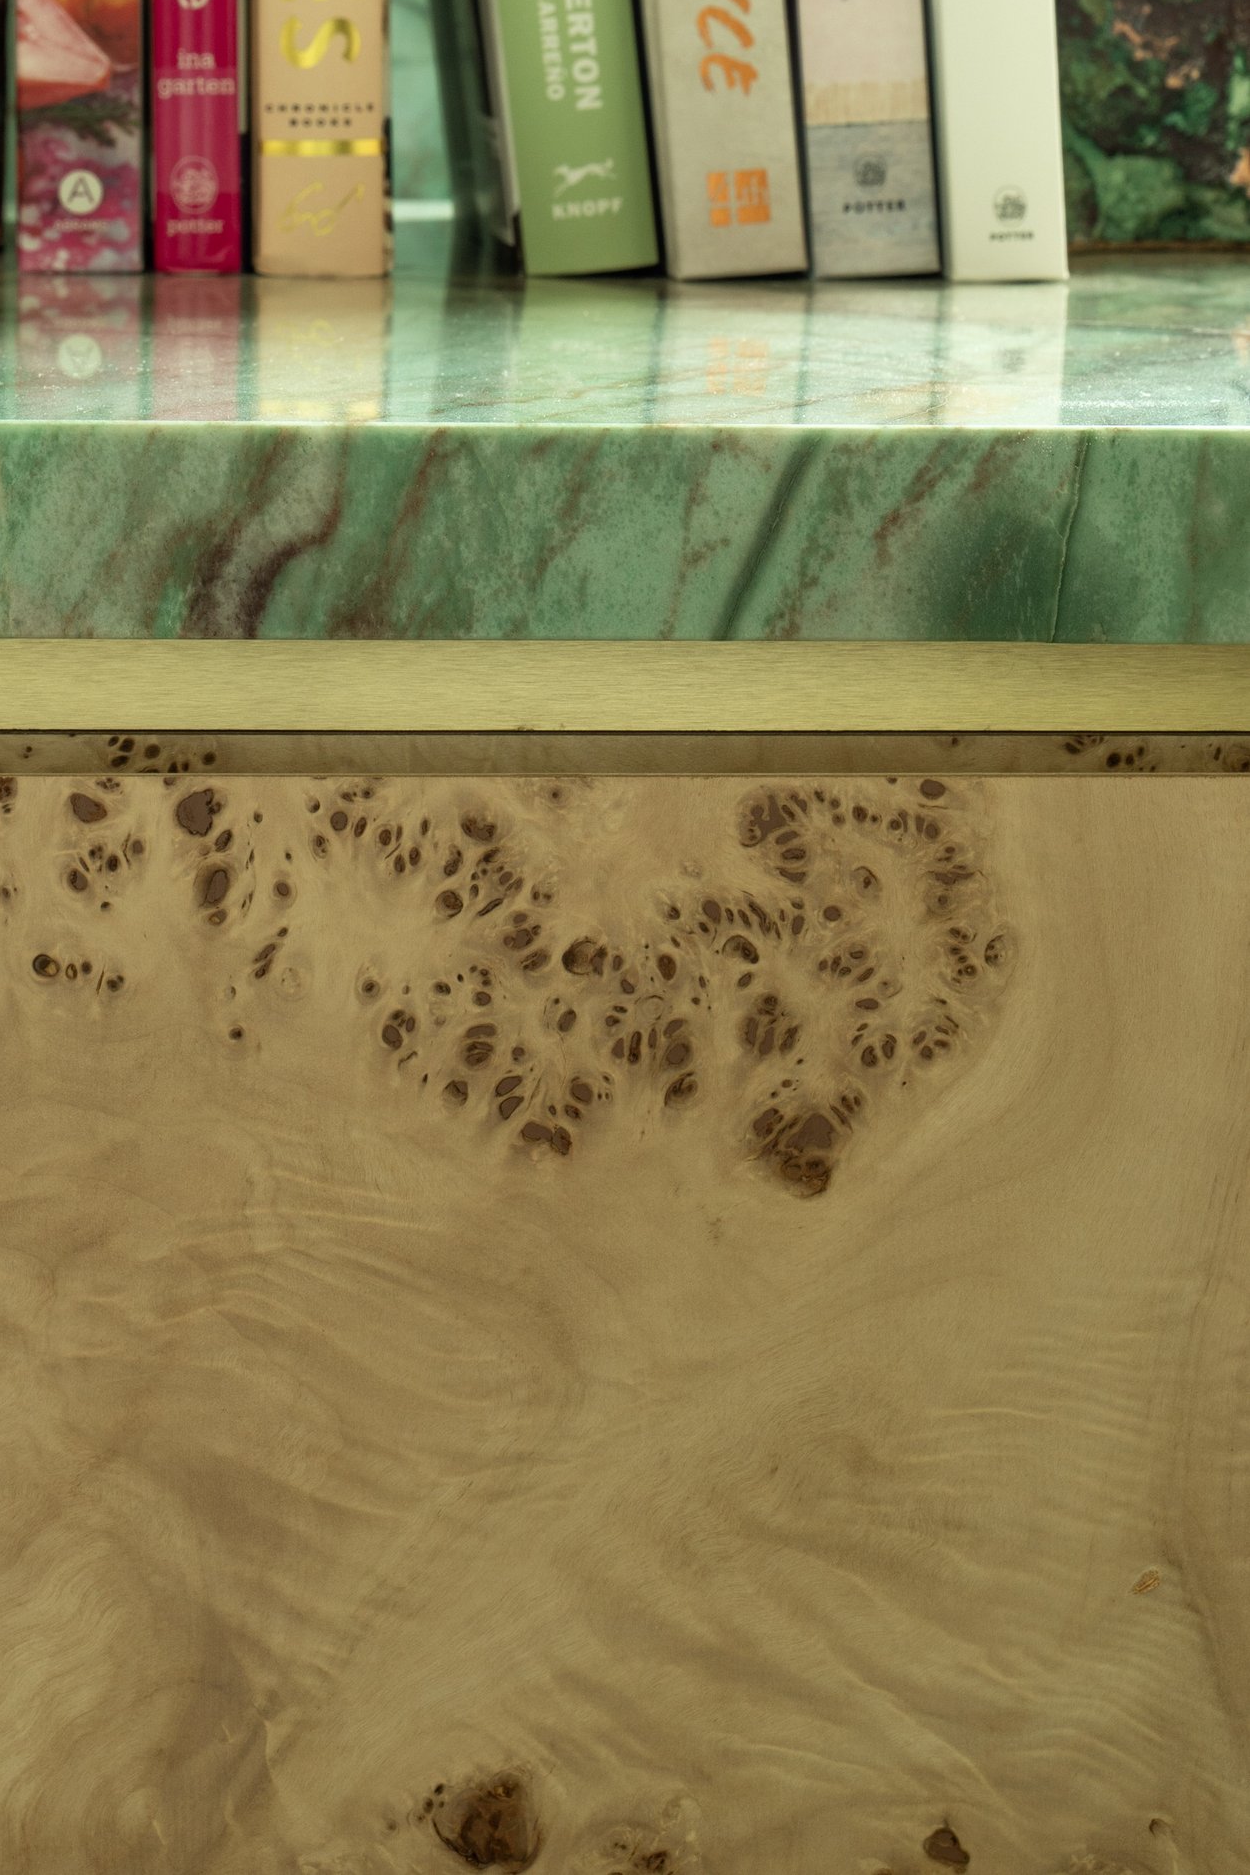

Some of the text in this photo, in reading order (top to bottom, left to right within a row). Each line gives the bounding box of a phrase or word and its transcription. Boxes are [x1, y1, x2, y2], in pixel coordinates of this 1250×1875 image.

[177, 47, 216, 70] ina
[157, 76, 236, 100] garten
[552, 197, 623, 221] KNOPF
[843, 200, 906, 214] POTTER
